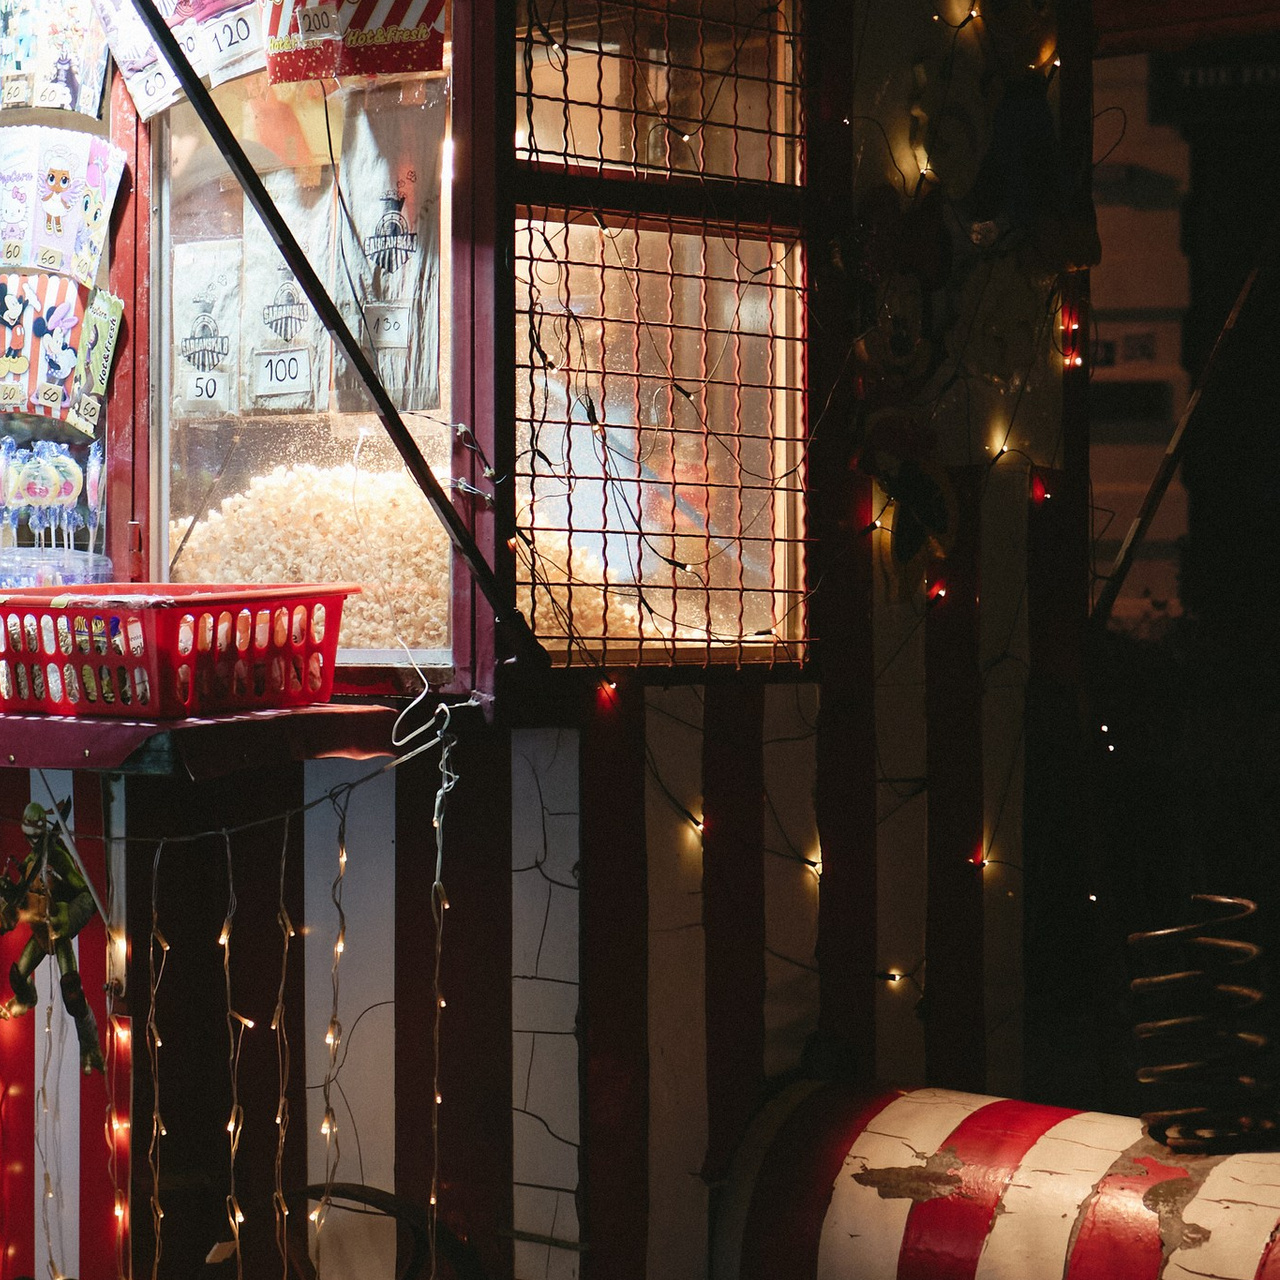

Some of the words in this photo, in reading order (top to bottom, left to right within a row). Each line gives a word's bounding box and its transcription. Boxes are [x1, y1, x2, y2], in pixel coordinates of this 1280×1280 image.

[302, 11, 330, 32] 200
[212, 17, 250, 52] 120
[346, 23, 429, 45] Hot&Fresh
[144, 72, 166, 97] 60
[6, 86, 21, 101] 60
[39, 87, 57, 102] 60
[5, 245, 21, 260] 60
[41, 251, 56, 265] 60
[76, 259, 89, 275] 60
[373, 317, 401, 334] 130
[98, 317, 117, 385] Hot&Fresh
[264, 357, 299, 382] 100
[2, 390, 16, 402] 60
[43, 389, 58, 402] 60
[195, 377, 217, 399] 50
[82, 402, 97, 418] 60
